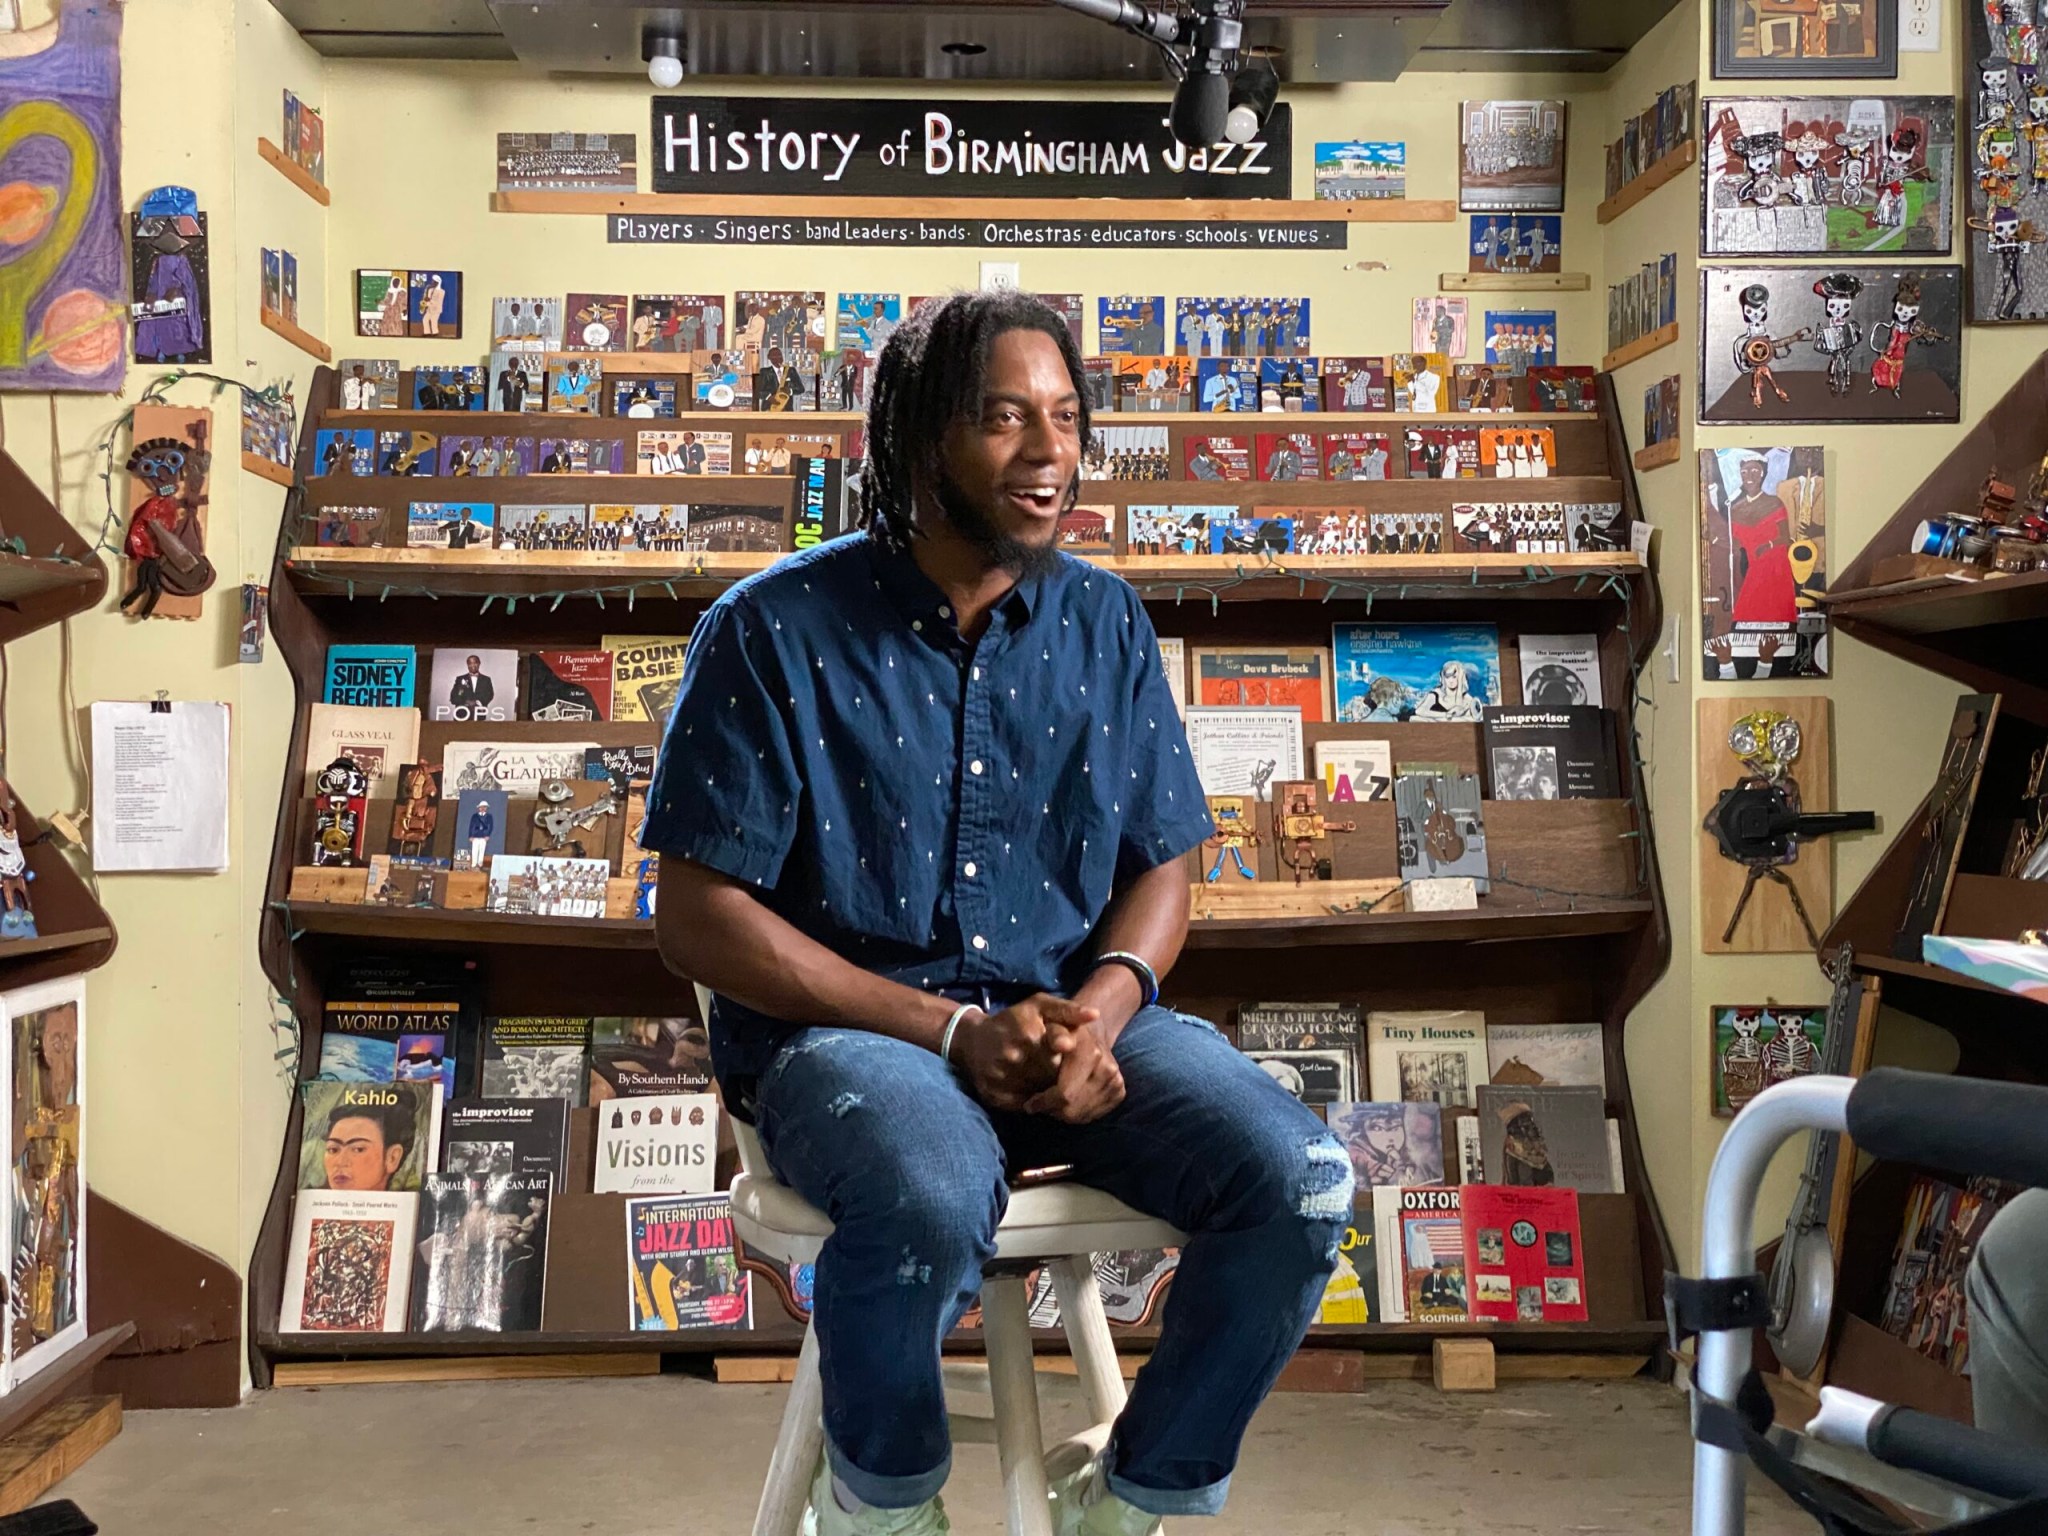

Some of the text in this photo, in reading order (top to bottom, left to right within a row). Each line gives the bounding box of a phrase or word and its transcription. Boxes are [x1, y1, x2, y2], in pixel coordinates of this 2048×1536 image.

[664, 113, 860, 181] History
[879, 130, 911, 167] of
[617, 218, 694, 240] Players
[714, 220, 793, 241] Singers
[806, 220, 841, 239] band
[845, 221, 908, 240] Leaders
[920, 222, 966, 240] bands
[984, 223, 1082, 243] Orchestras
[1091, 225, 1176, 242] educators
[1185, 226, 1248, 243] schools
[807, 457, 826, 522] JAZZ MAN
[1350, 629, 1400, 640] after hours
[559, 655, 605, 664] I Remember
[616, 643, 689, 666] COUNT
[333, 664, 407, 687] SIDNEY
[571, 664, 588, 673] Jazz
[616, 661, 677, 681] BASIE
[1243, 664, 1268, 674] Dave
[1271, 664, 1310, 674] Brubeck
[331, 688, 406, 708] BECHET
[435, 705, 506, 722] POPS
[1500, 713, 1570, 724] improvisor
[331, 729, 365, 739] GLASS
[512, 756, 525, 764] LA
[602, 749, 629, 772] Really
[493, 760, 558, 780] GLAIVE
[626, 763, 650, 776] Blues
[1325, 760, 1391, 803] JAZZ
[337, 1014, 450, 1031] WORLD ATLAS
[544, 1018, 565, 1026] FROM
[1241, 1012, 1357, 1023] WHERE IS THE SONG
[493, 1026, 509, 1034] AND
[510, 1026, 538, 1034] ROMAN
[1241, 1023, 1357, 1034] OF SONGS FOR ME
[1382, 1026, 1417, 1042] Tiny
[1421, 1026, 1475, 1039] Houses
[618, 1073, 709, 1086] By Southern Hands
[344, 1090, 398, 1105] Kahlo
[462, 1107, 534, 1118] improvisor
[607, 1138, 705, 1168] Visions
[527, 1178, 547, 1190] ART
[631, 1174, 676, 1189] from the
[1404, 1191, 1460, 1209] OXFOR
[639, 1221, 692, 1253] JAZZ
[669, 1250, 688, 1258] STUART
